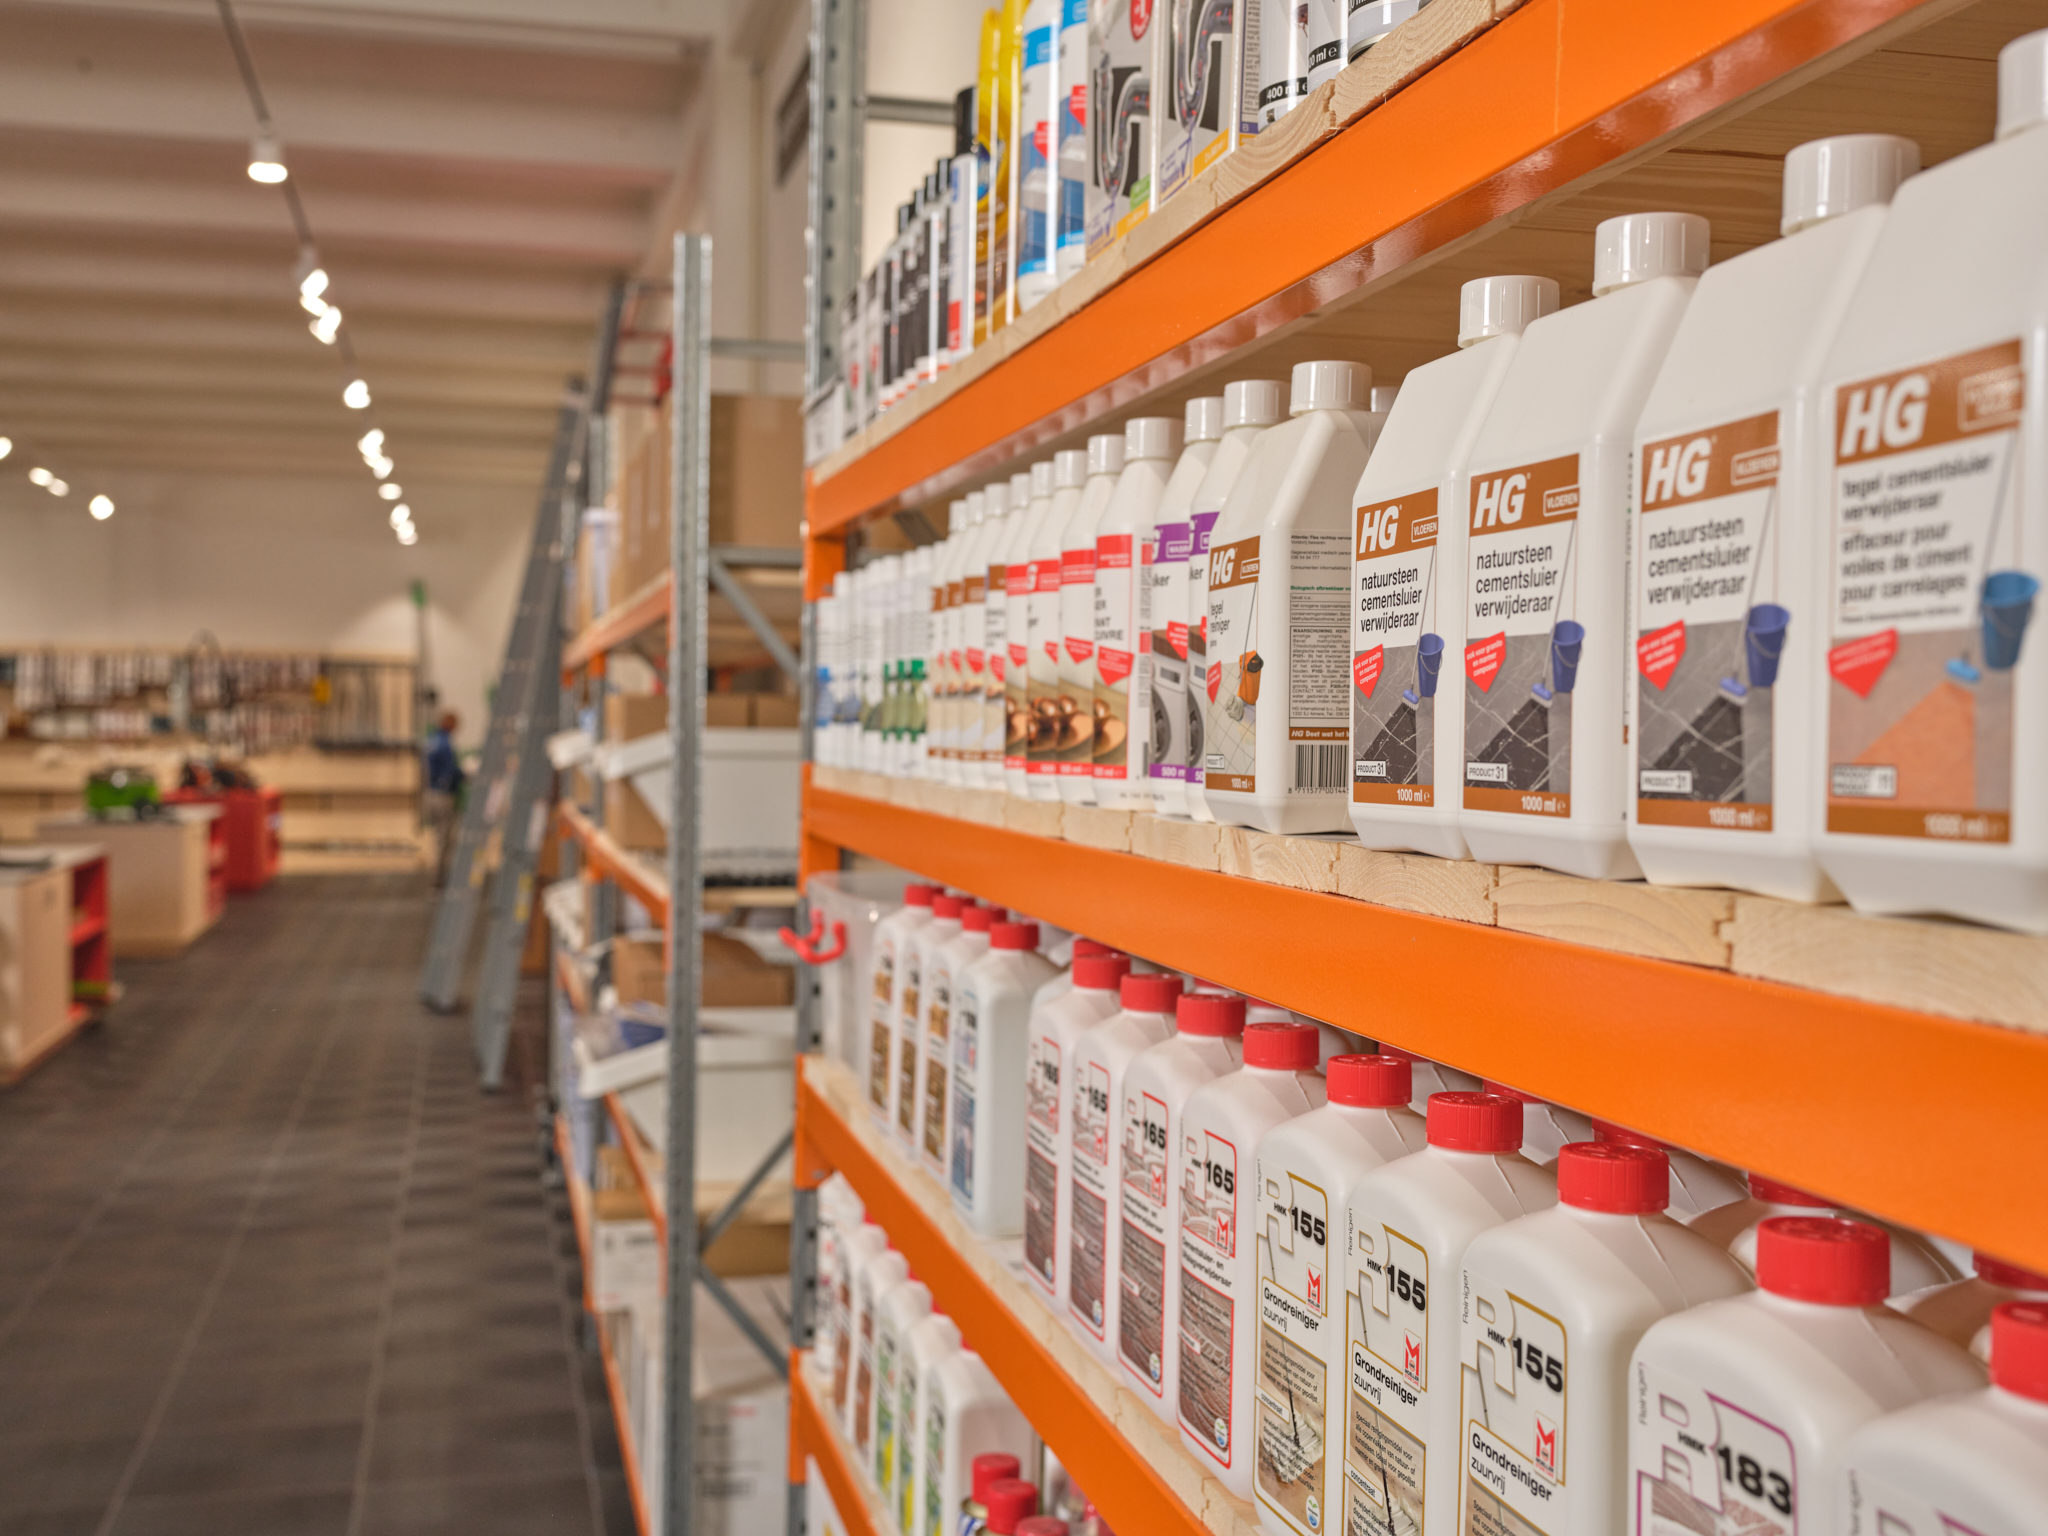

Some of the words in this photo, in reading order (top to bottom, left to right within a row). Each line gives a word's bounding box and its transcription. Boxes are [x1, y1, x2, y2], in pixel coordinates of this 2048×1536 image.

[1316, 49, 1326, 61] ml
[1267, 86, 1282, 100] 400
[1285, 82, 1300, 96] ml
[1838, 374, 1930, 459] HG
[1644, 436, 1712, 504] HG
[1843, 473, 1880, 498] tegel
[1887, 455, 1991, 488] cementsluier
[1473, 473, 1526, 529] HG
[1546, 492, 1578, 510] VLOEREN
[1842, 492, 1942, 522] verwijderaar
[1359, 505, 1399, 554] HG
[1414, 521, 1437, 536] VLOEREN
[1648, 517, 1744, 550] natuursteen
[1210, 548, 1236, 586] HG
[1476, 545, 1552, 570] natuursteen
[1648, 542, 1751, 578] cementsluier
[1362, 568, 1418, 590] natuursteen
[1476, 566, 1558, 594] cementsluier
[1648, 575, 1747, 606] verwijderaar
[1361, 586, 1422, 612] cementsluier
[1475, 594, 1554, 620] verwijderaar
[1360, 610, 1420, 634] verwijderaar
[1361, 658, 1369, 668] voor
[1368, 651, 1382, 665] granito
[1472, 658, 1479, 668] en
[1479, 652, 1497, 665] marmer
[1475, 646, 1486, 658] voor
[1486, 639, 1503, 655] granito
[1359, 668, 1364, 677] en
[1364, 662, 1378, 674] marmer
[1359, 670, 1378, 686] composiet
[1473, 661, 1498, 677] composiet
[1161, 767, 1177, 777] 500
[1357, 764, 1376, 774] PRODUCT
[1377, 762, 1384, 774] 31
[1469, 767, 1494, 778] PRODUCT
[1495, 766, 1505, 780] 31
[1397, 788, 1413, 802] 1000
[1414, 789, 1422, 802] ml
[1521, 796, 1543, 812] 1000
[1544, 798, 1556, 812] ml
[1709, 807, 1736, 826] 1000
[1738, 808, 1755, 827] ml
[1089, 1086, 1108, 1114] 165
[1143, 1119, 1166, 1150] 165
[1206, 1160, 1234, 1195] 165
[1274, 1202, 1287, 1217] HMK
[1291, 1206, 1326, 1246] 155
[1367, 1258, 1382, 1275] HMK
[1387, 1264, 1426, 1312] 155
[1263, 1306, 1288, 1332] zuurvrij
[1264, 1286, 1319, 1332] Grondreiniger
[1488, 1327, 1506, 1348] HMK
[1512, 1336, 1563, 1393] 155
[1354, 1352, 1418, 1408] Grondreiniger
[1354, 1373, 1381, 1405] zuurvrij
[1355, 1411, 1371, 1429] Speciaal
[1371, 1425, 1403, 1454] reinigingsmiddel
[1403, 1450, 1413, 1461] voor
[1387, 1462, 1398, 1474] voor
[1398, 1470, 1416, 1488] gepolijst
[1395, 1455, 1410, 1471] natuur-
[1411, 1467, 1416, 1476] of
[1471, 1456, 1506, 1495] zuurvrij
[1472, 1432, 1552, 1502] Grondreiniger
[1678, 1431, 1707, 1456] HMK
[1717, 1446, 1792, 1516] 183
[1473, 1499, 1492, 1521] Speciaal
